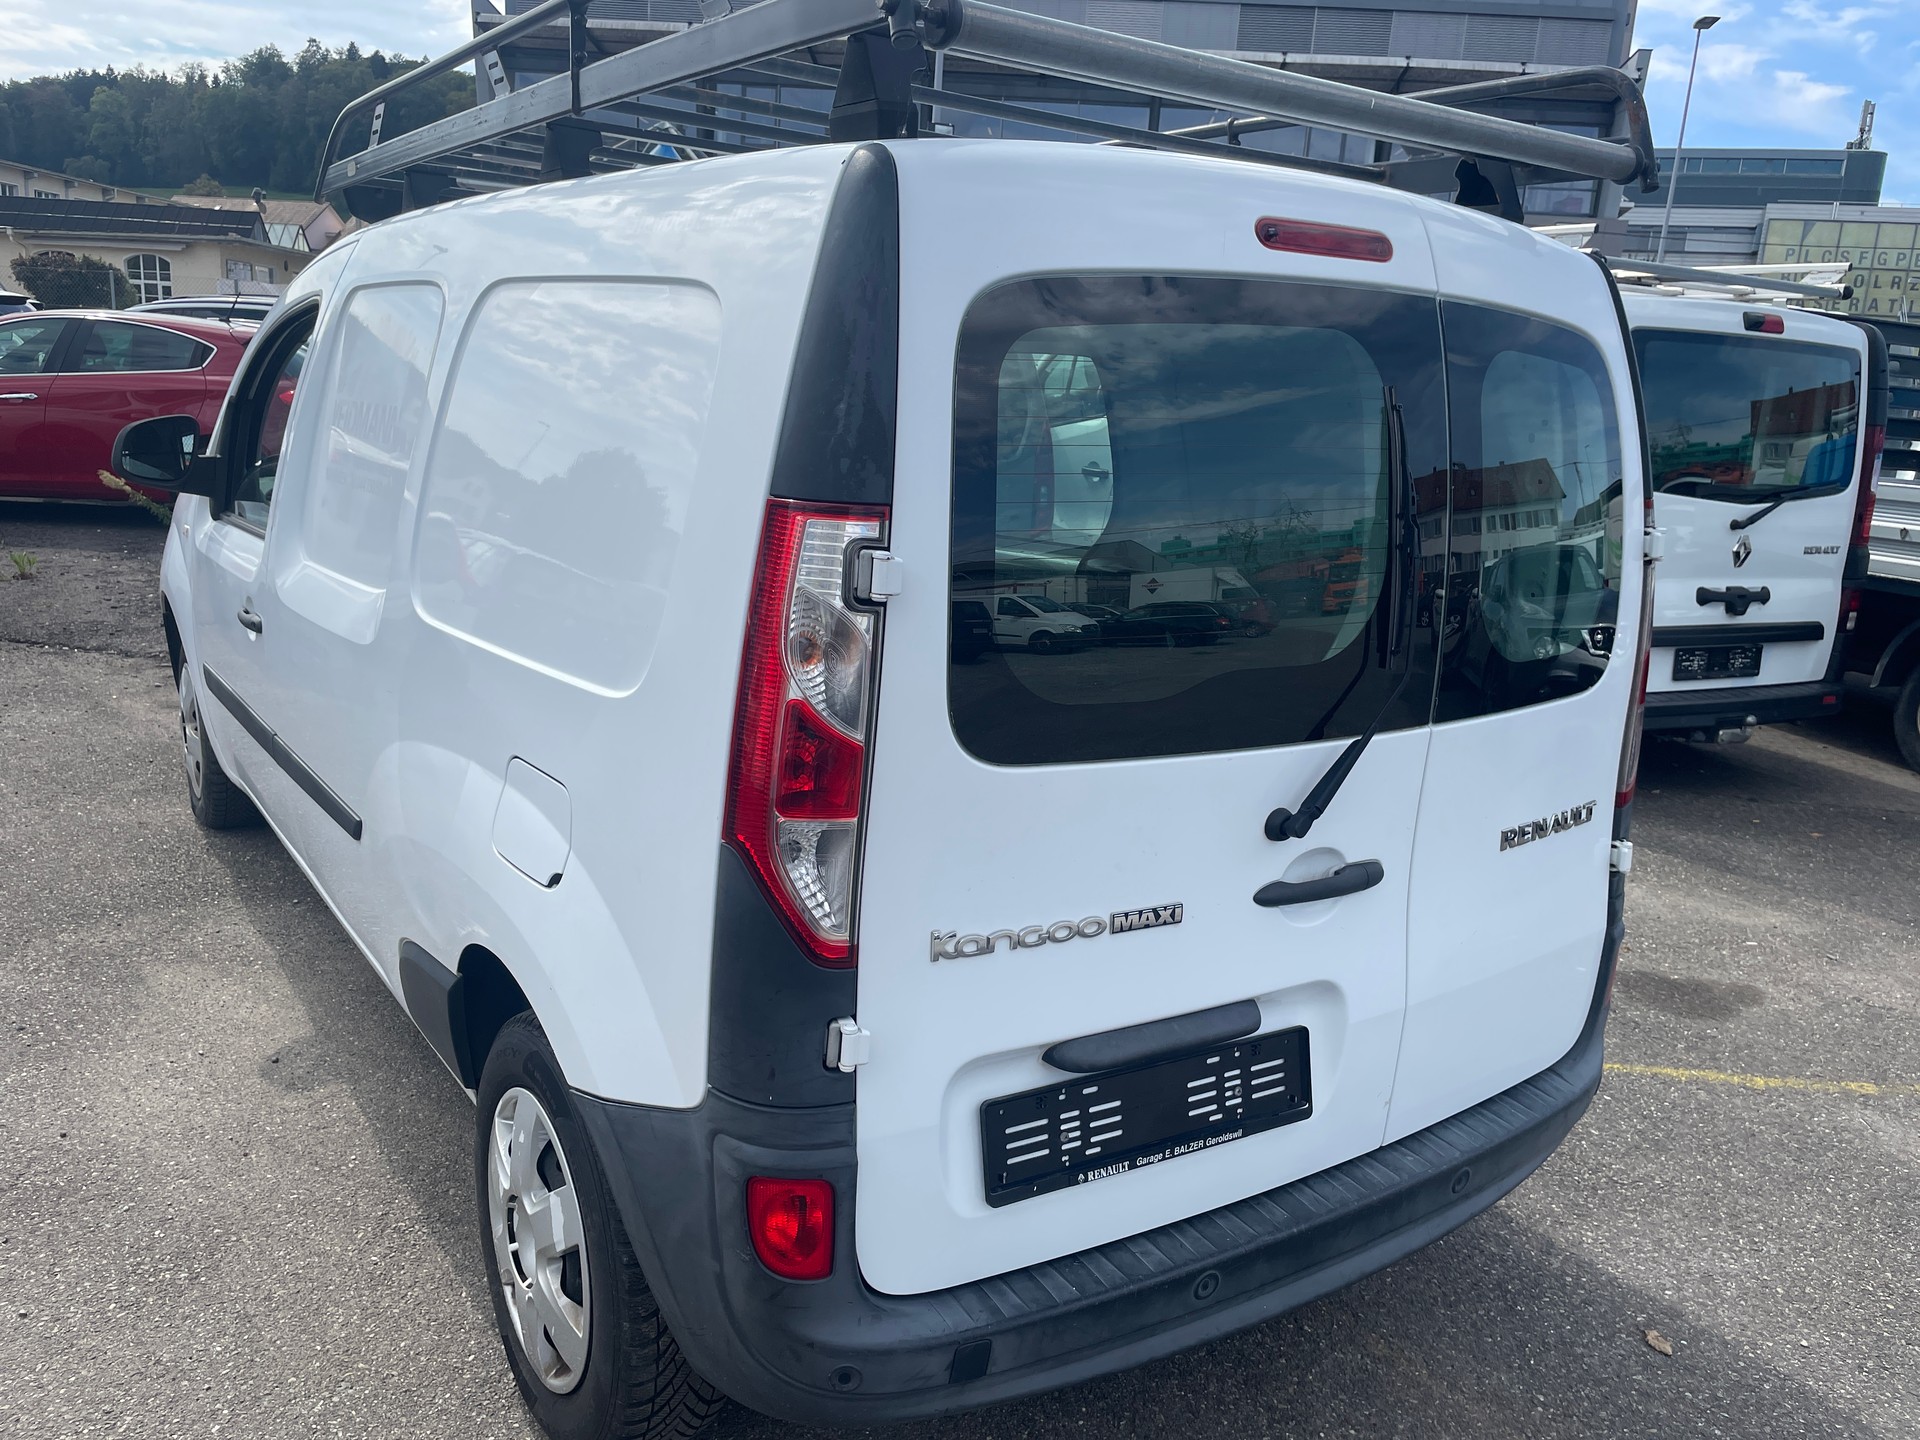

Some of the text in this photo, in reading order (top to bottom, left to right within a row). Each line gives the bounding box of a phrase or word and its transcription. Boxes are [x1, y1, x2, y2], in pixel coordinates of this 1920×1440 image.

[1500, 800, 1597, 852] RENAULT
[1087, 1129, 1243, 1182] RENAULT Garage E. BALZER Geroldswil
